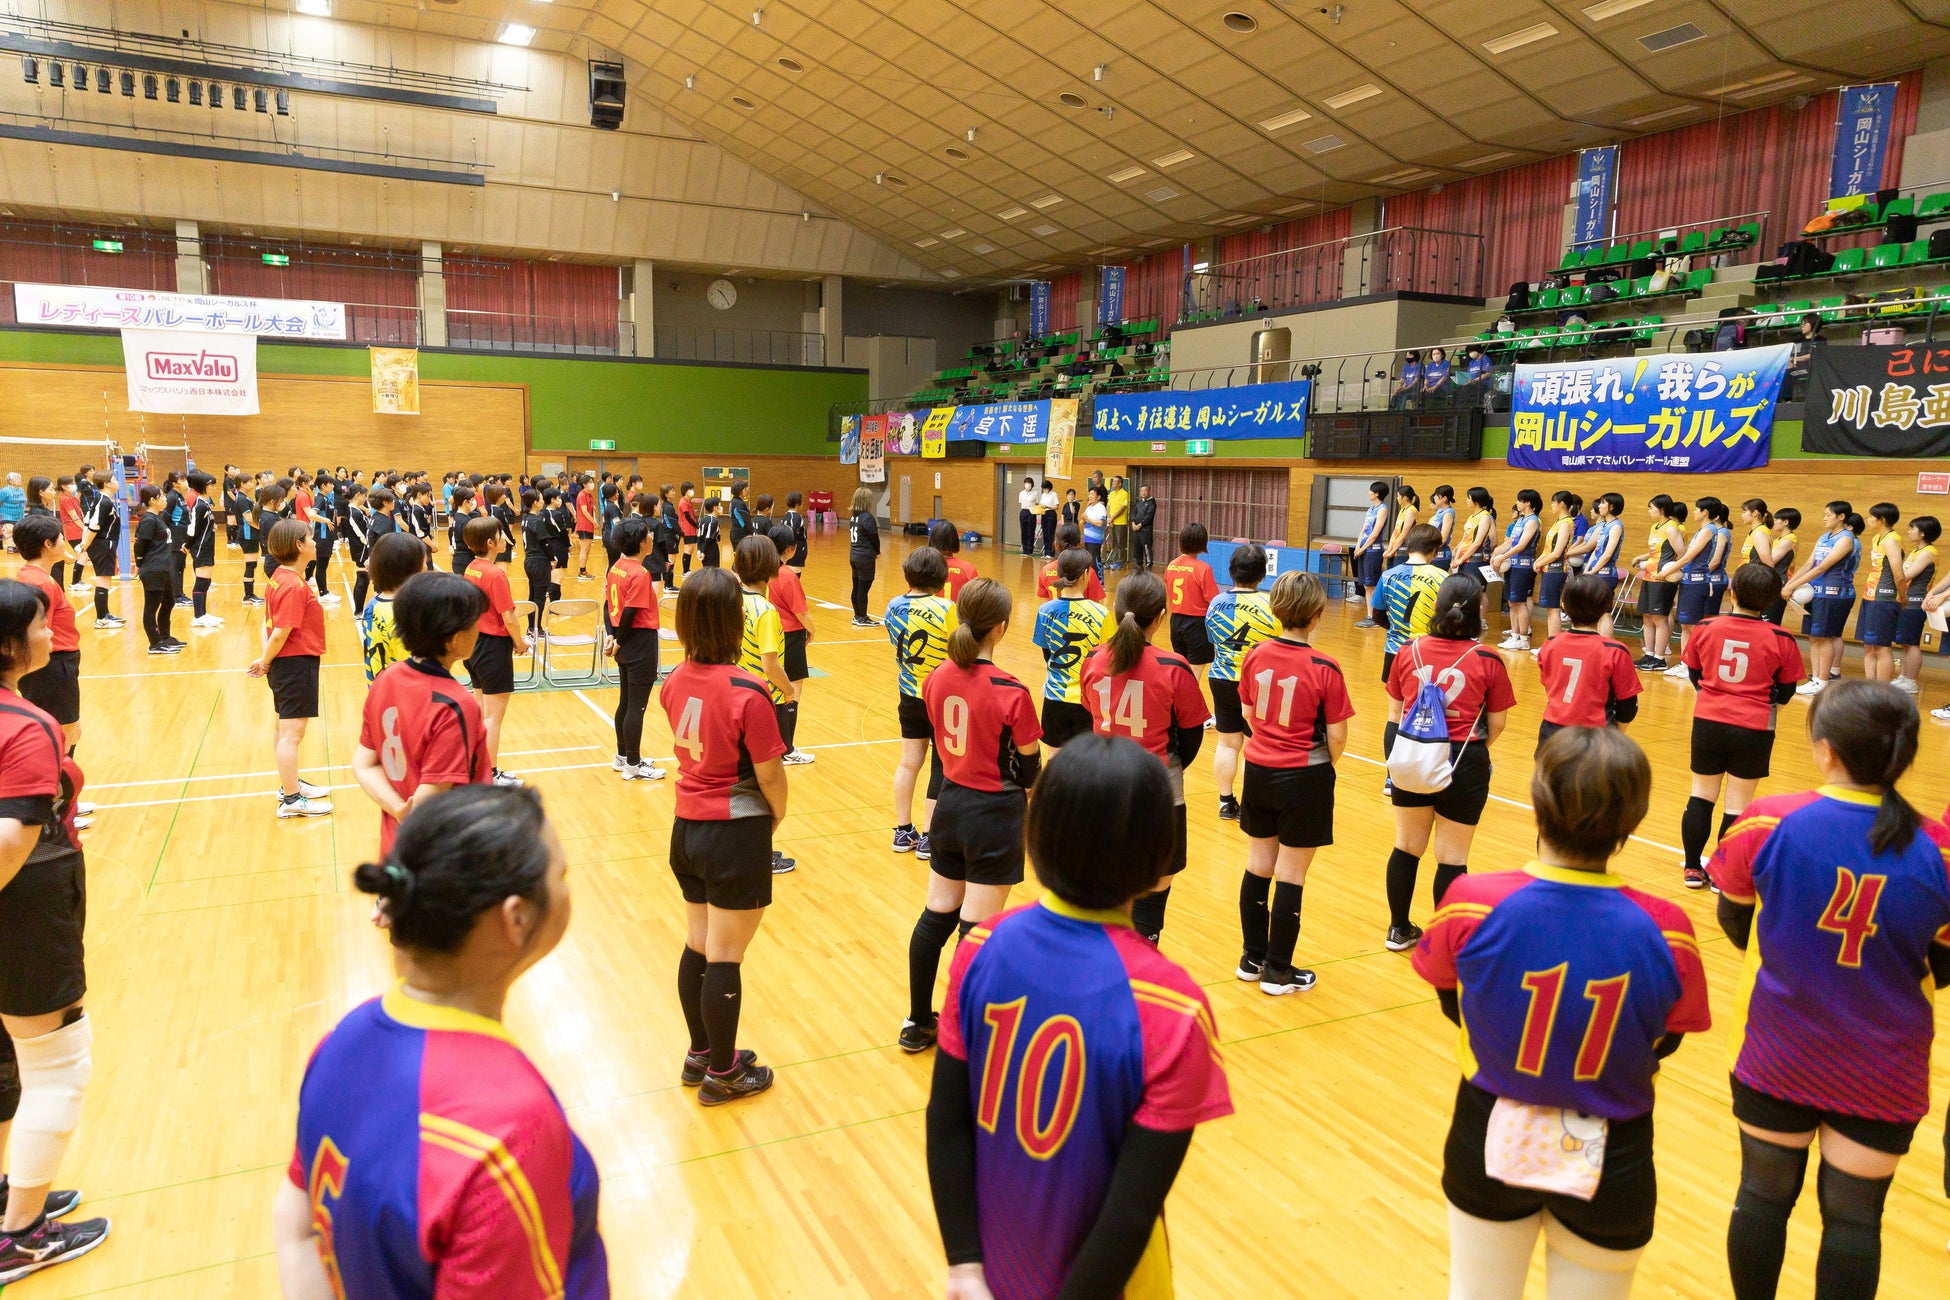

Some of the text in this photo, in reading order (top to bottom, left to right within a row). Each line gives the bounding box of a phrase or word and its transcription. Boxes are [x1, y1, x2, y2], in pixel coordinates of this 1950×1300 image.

[39, 300, 306, 334] レディースバレーボール大会
[154, 350, 231, 377] MaxValu
[1658, 360, 1758, 402] 我らが
[1095, 395, 1306, 431] 頂点へ 勇往邁進 岡山シーガルズ
[1513, 398, 1769, 452] 岡山シーガルズ
[1561, 454, 1690, 468] 岡山県ママさんバレーボール連盟
[610, 583, 619, 617] 9
[1172, 577, 1184, 606] 5
[1402, 590, 1421, 624] 1
[896, 628, 929, 665] 12
[1050, 632, 1089, 669] 5
[1221, 621, 1250, 649] 4
[1562, 657, 1583, 703] 7
[1717, 639, 1751, 683] 5
[1092, 676, 1148, 738] 14
[1254, 668, 1298, 728] 11
[1412, 664, 1466, 717] 12
[381, 706, 407, 782] 8
[674, 696, 704, 763] 4
[943, 695, 969, 757] 9
[1816, 866, 1888, 968] 4
[1515, 961, 1631, 1081] 11
[977, 995, 1087, 1161] 10
